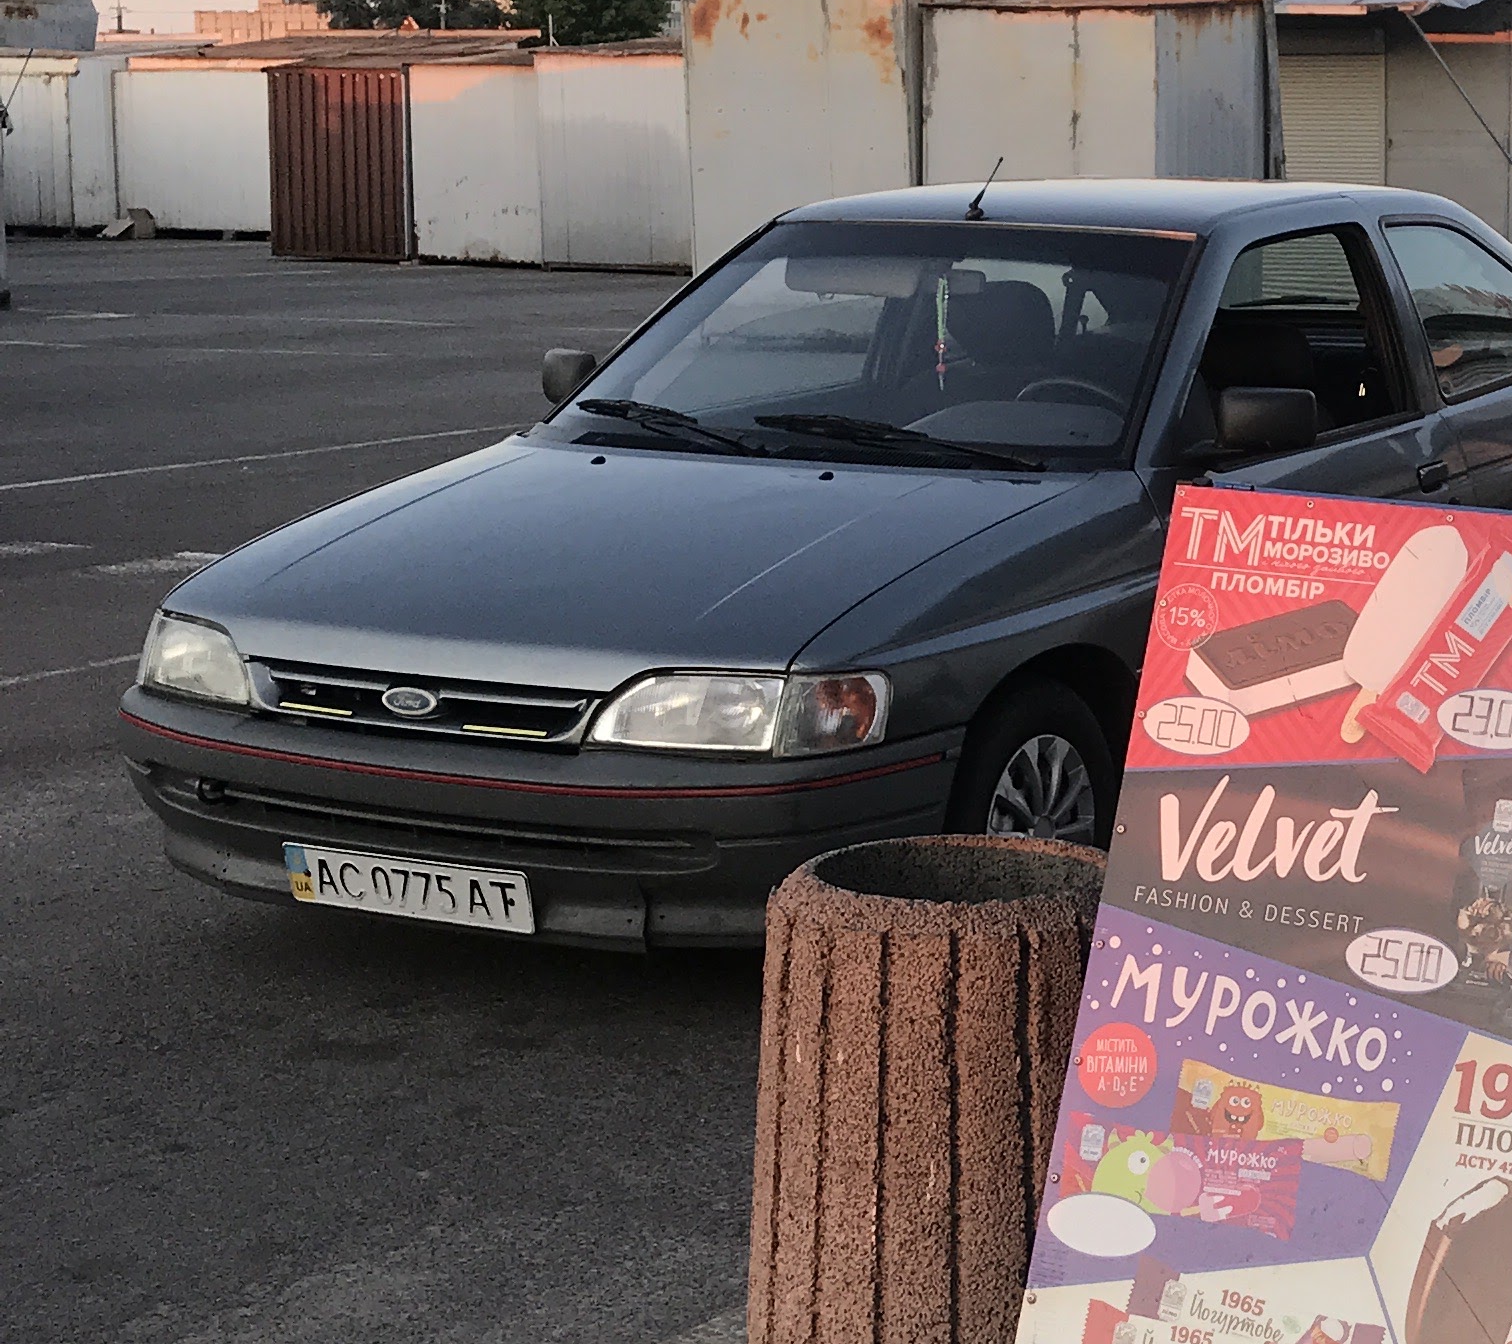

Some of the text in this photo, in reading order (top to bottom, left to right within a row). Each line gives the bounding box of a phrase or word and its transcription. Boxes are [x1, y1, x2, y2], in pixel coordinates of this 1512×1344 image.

[1181, 506, 1266, 566] ТМ
[1268, 515, 1376, 548] ТІЛЬКИ
[1263, 541, 1390, 570] МОРОЗИВО
[1211, 572, 1325, 600] ПЛОМБІР
[1169, 606, 1206, 628] 15%
[1410, 630, 1475, 696] ТМ
[1160, 775, 1400, 883] Velvet
[295, 881, 312, 894] UA
[317, 858, 516, 922] AC 0775 AT
[1133, 885, 1364, 934] FASHION & DESSERT
[1110, 954, 1388, 1071] МУРОЖКО
[1096, 1038, 1138, 1053] МІСТИТЬ
[1086, 1055, 1148, 1074] ВІТАМІНИ
[1271, 1098, 1352, 1128] МУРОЖКО
[1205, 1148, 1276, 1169] МУРОЖКО
[1455, 1153, 1498, 1172] ДСТУ
[1189, 1289, 1285, 1343] Йогуртове
[1221, 1289, 1266, 1317] 1965
